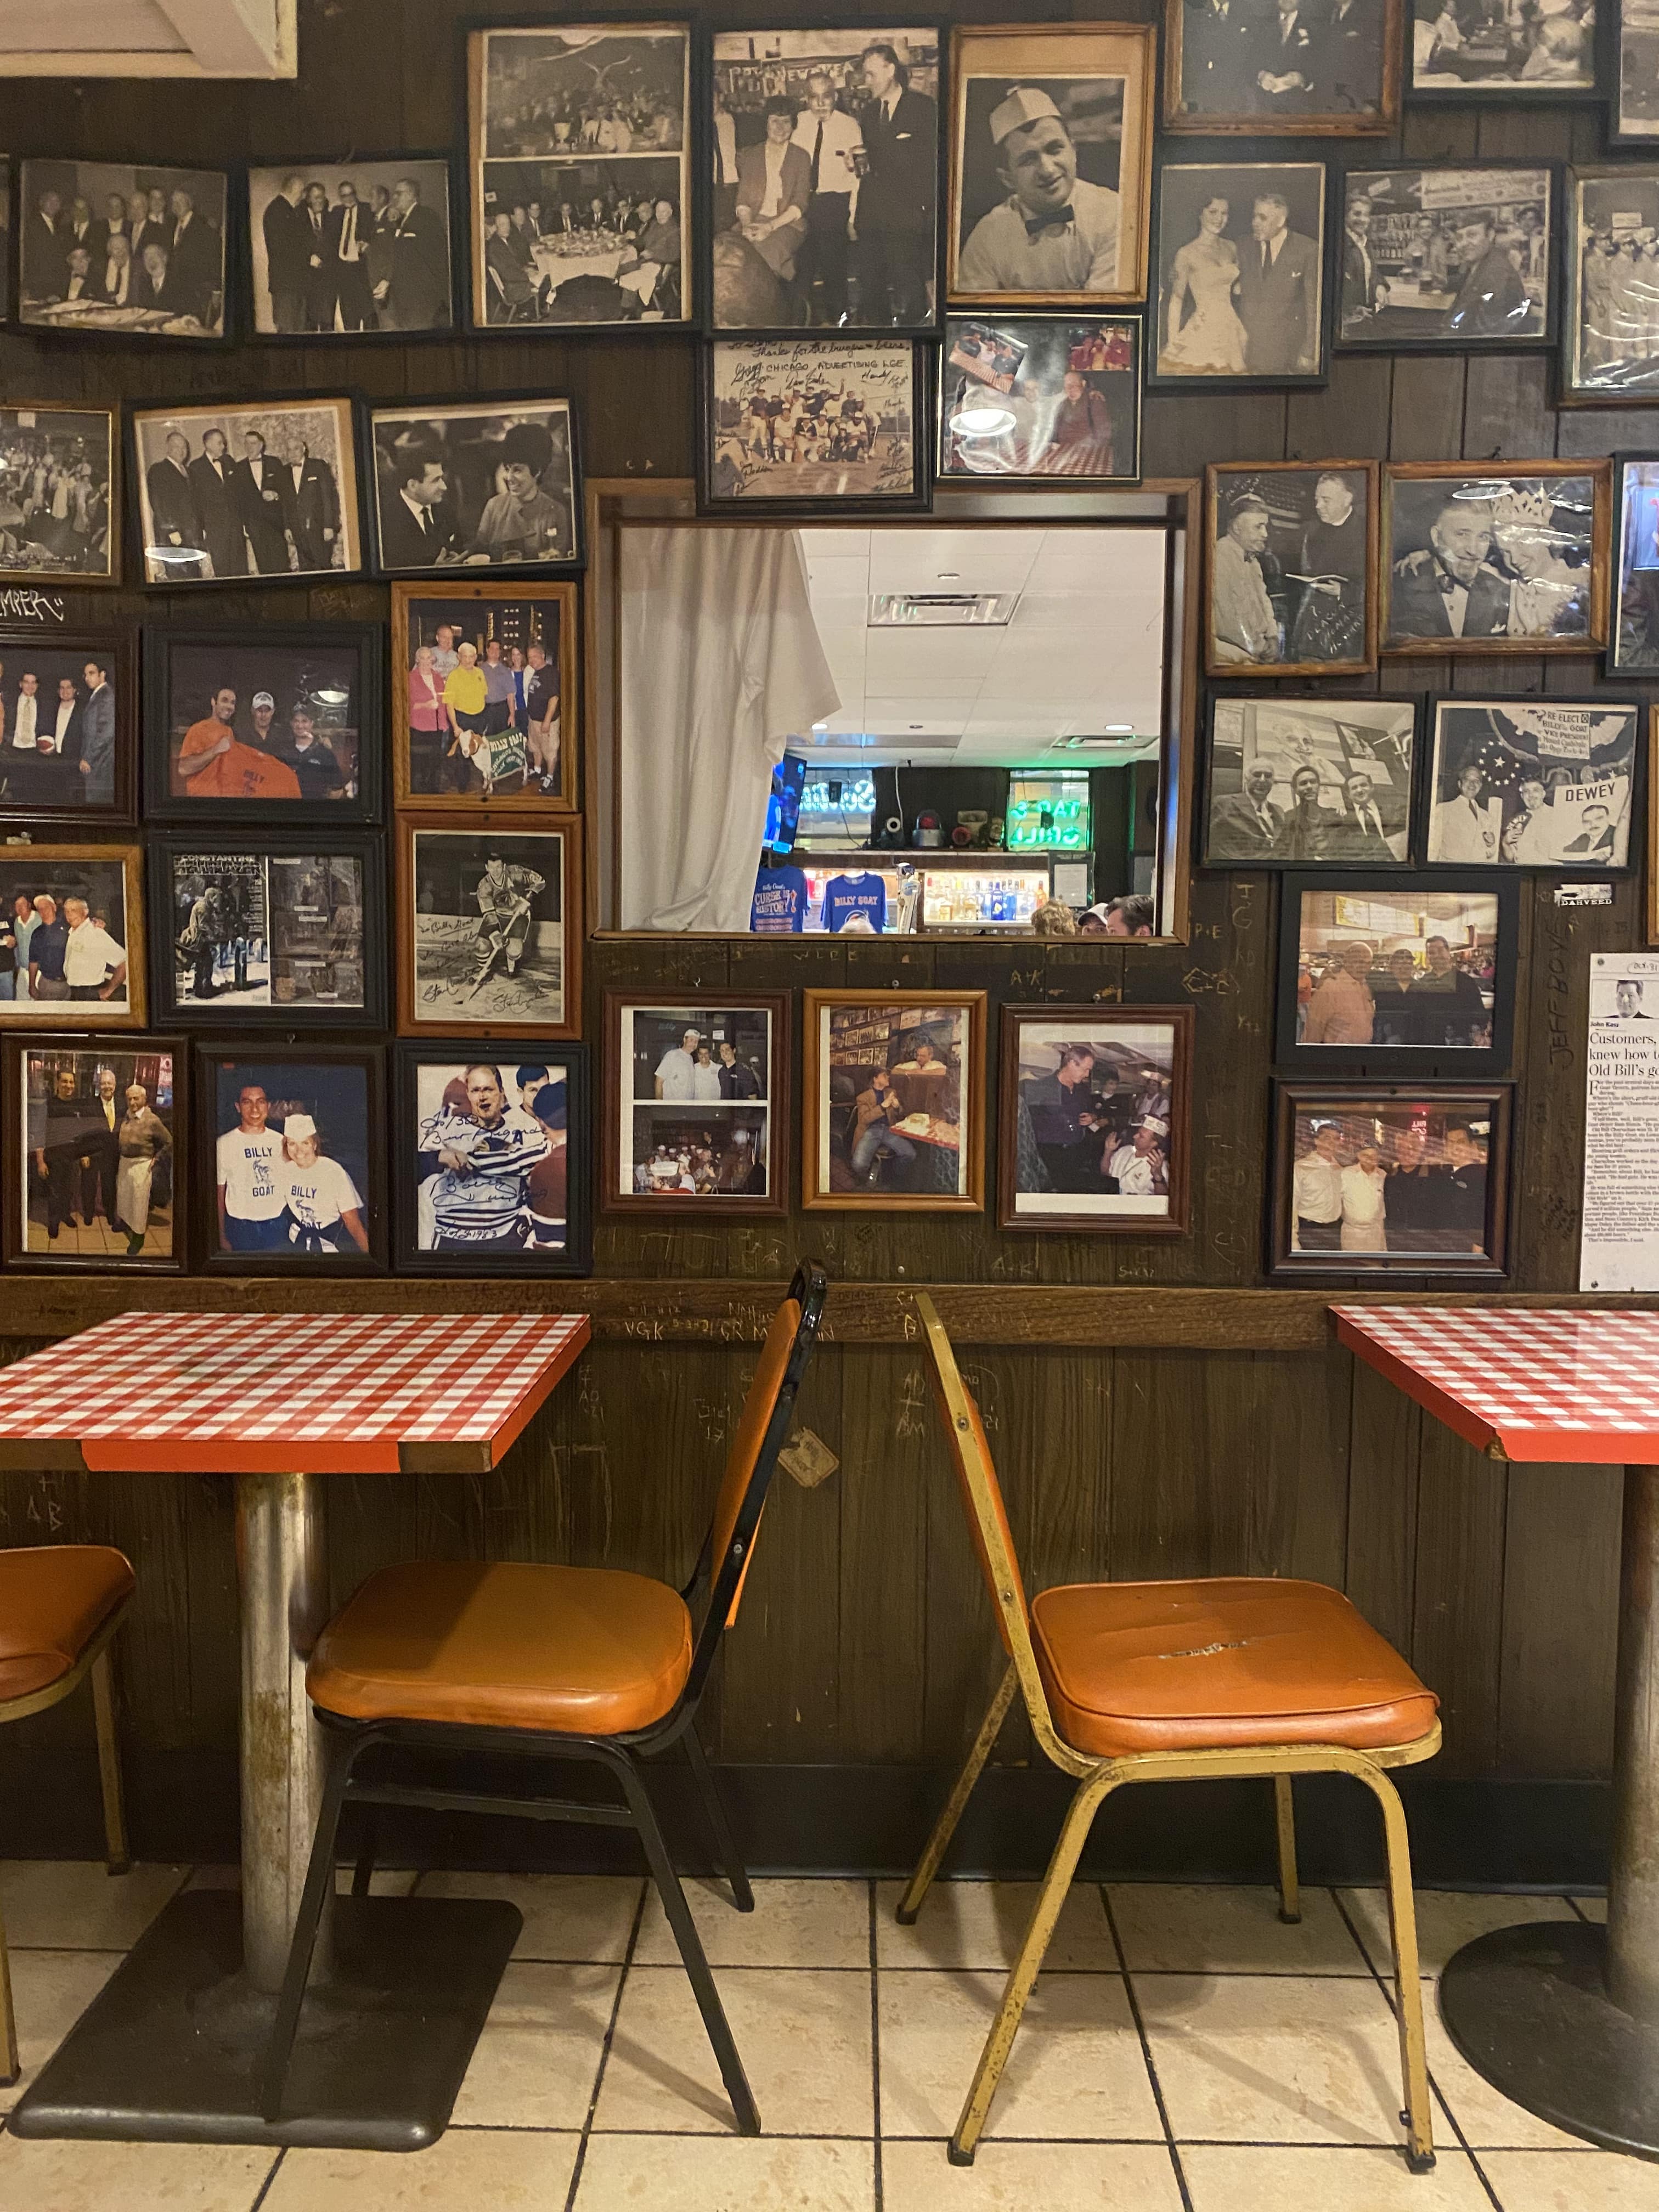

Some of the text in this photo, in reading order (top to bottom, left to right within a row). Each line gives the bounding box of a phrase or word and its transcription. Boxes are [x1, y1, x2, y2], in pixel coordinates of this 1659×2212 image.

[766, 362, 809, 371] CHICAGO
[1565, 782, 1616, 802] DEWEY
[834, 895, 856, 907] BILLY
[1590, 1032, 1657, 1045] Customers,
[1589, 1048, 1621, 1060] knew
[1625, 1048, 1649, 1060] how
[1589, 1064, 1610, 1076] Old
[1615, 1064, 1645, 1076] Bill's
[244, 1147, 273, 1159] BILLY
[252, 1185, 275, 1197] GOAT
[291, 1185, 317, 1199] BILLY
